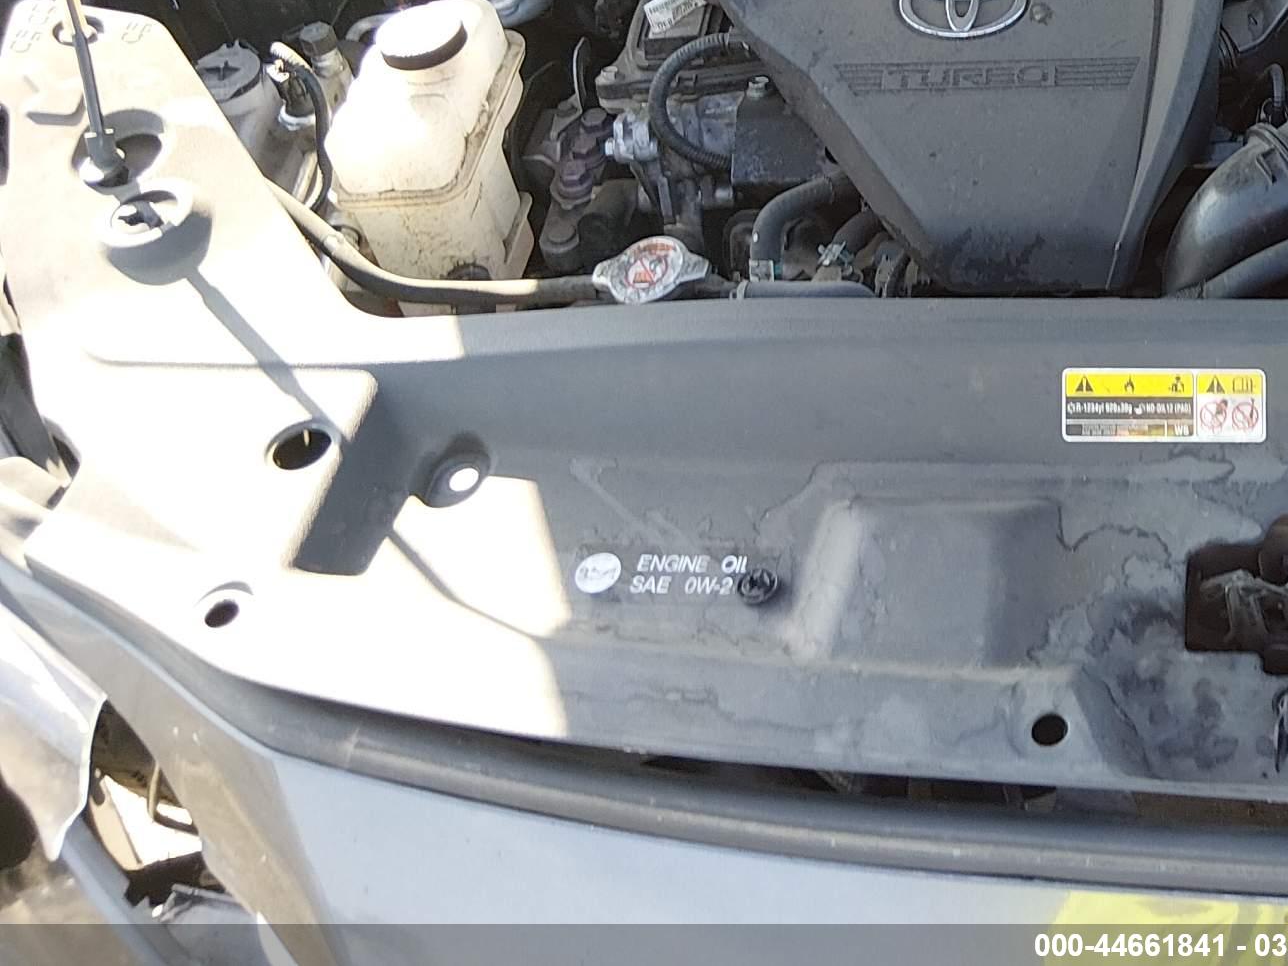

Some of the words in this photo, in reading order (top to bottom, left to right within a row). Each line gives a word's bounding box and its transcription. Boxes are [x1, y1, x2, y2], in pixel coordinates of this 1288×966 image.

[887, 65, 1049, 88] TURBO
[637, 554, 710, 573] ENGINE
[721, 554, 748, 574] OIL
[629, 575, 672, 595] SAE
[684, 575, 736, 595] 0W-2
